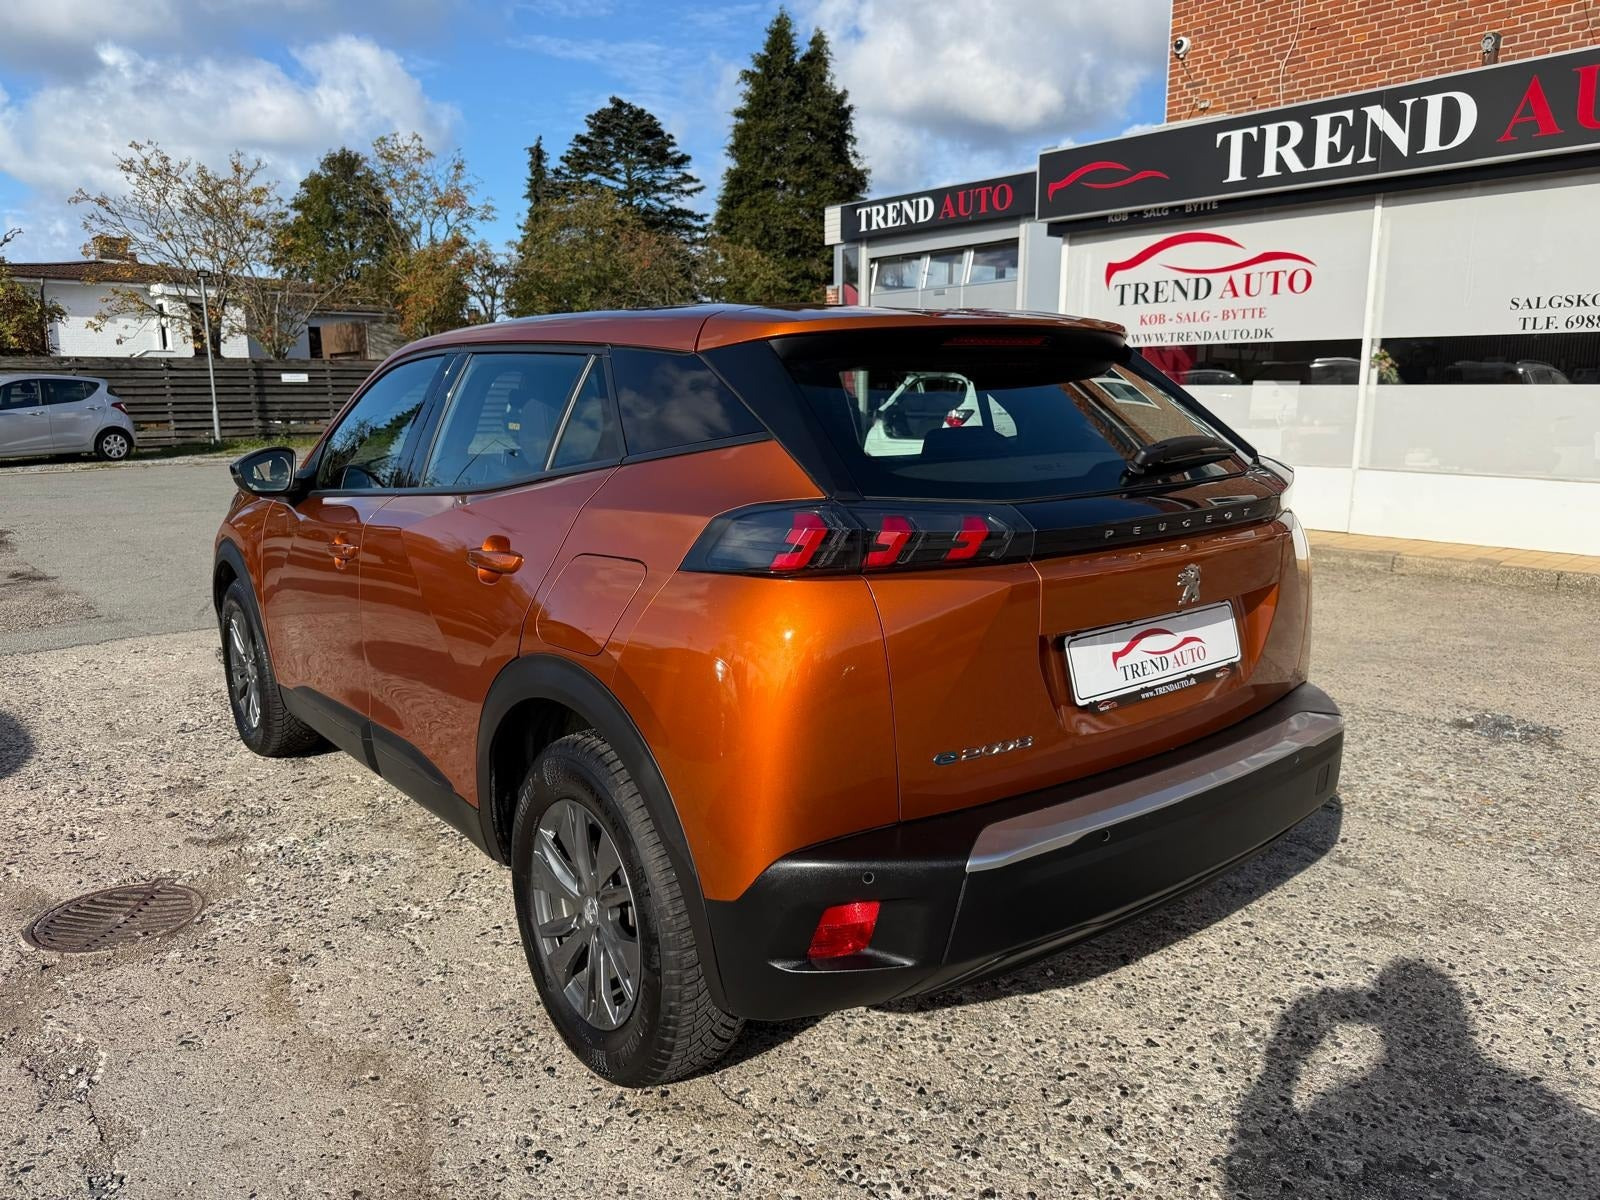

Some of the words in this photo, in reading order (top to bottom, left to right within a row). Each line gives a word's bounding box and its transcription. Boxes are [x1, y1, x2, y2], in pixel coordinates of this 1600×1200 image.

[1215, 90, 1478, 184] TREND
[856, 196, 935, 233] TREND
[938, 183, 1014, 220] AUTO
[1114, 276, 1212, 306] TREND
[1219, 268, 1312, 300] AUTO
[1139, 312, 1166, 327] KØB
[1175, 310, 1210, 325] SALG
[1221, 306, 1267, 322] BYTTE
[1518, 315, 1559, 331] TLF.
[1130, 327, 1275, 345] WWW.TRENDAUTO.DK
[1104, 507, 1250, 540] PEUGEOT
[1120, 655, 1169, 682] TREND
[1172, 645, 1207, 669] AUTO
[1140, 677, 1197, 700] www.TRENDAUTO.dk
